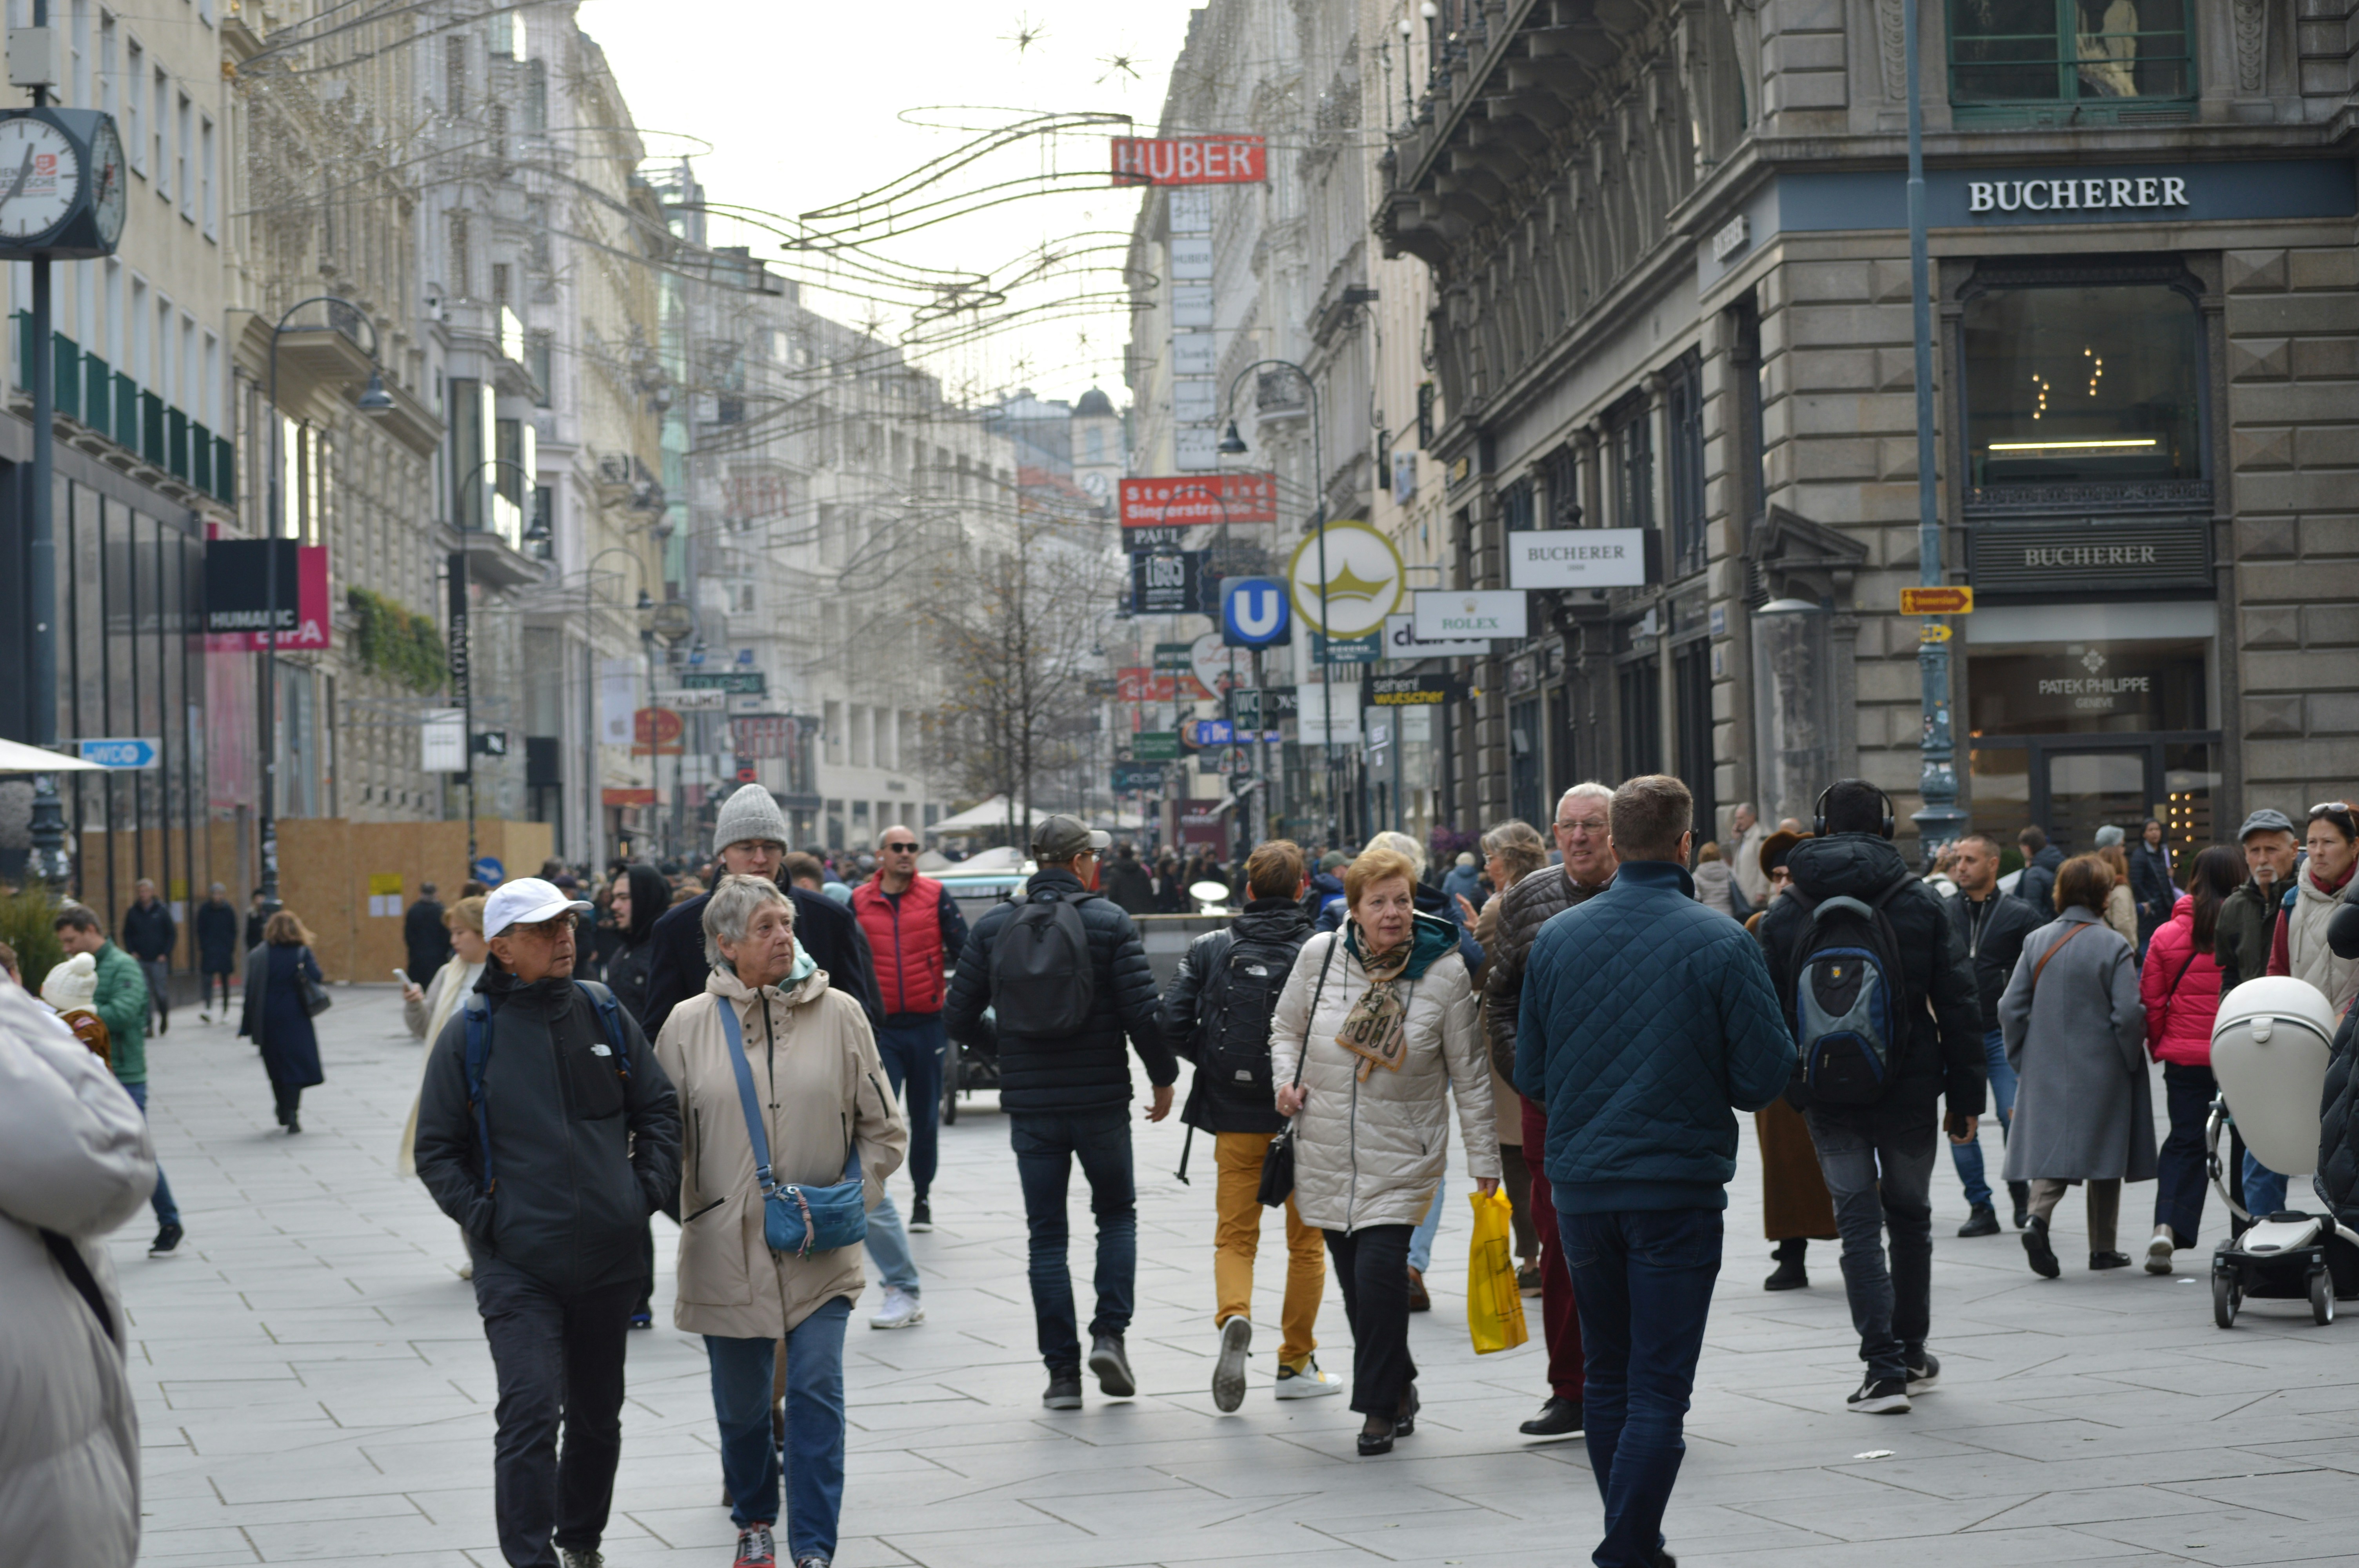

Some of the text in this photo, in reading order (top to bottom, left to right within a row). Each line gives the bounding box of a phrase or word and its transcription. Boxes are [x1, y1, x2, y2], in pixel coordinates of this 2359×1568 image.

[1118, 140, 1252, 180] HUBER
[1968, 177, 2190, 211] BUCHERER
[1528, 546, 1625, 561] BUCHERER
[2025, 545, 2156, 566] BUCHERER
[1234, 590, 1279, 637] U
[1442, 617, 1499, 630] ROLEX
[2039, 677, 2150, 694] PATEK PHILIPPE
[1374, 690, 1445, 705] wutscher
